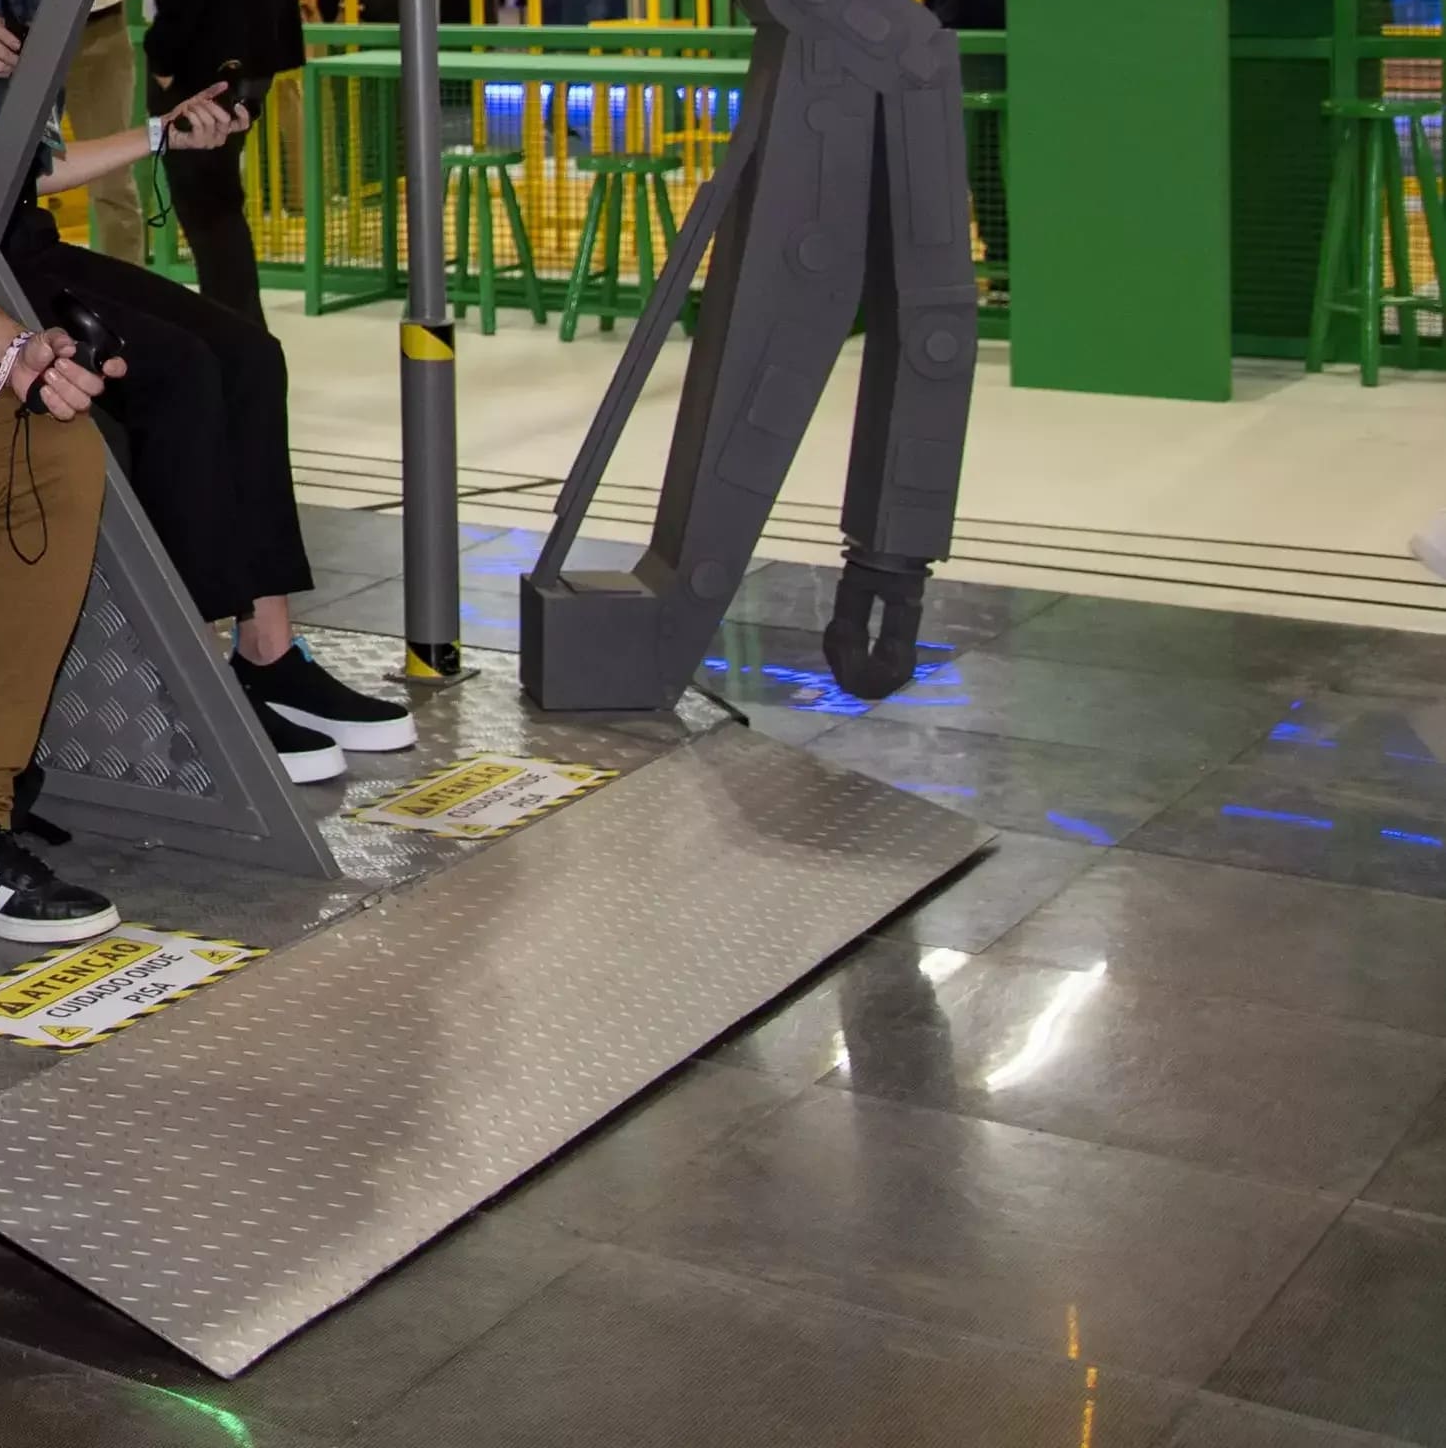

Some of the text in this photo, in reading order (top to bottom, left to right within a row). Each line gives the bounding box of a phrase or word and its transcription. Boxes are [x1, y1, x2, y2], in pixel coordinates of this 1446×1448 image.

[19, 942, 143, 1001] ATENÇÃO
[46, 952, 184, 1018] CUIDADO ONDE
[123, 981, 176, 1004] PISA
